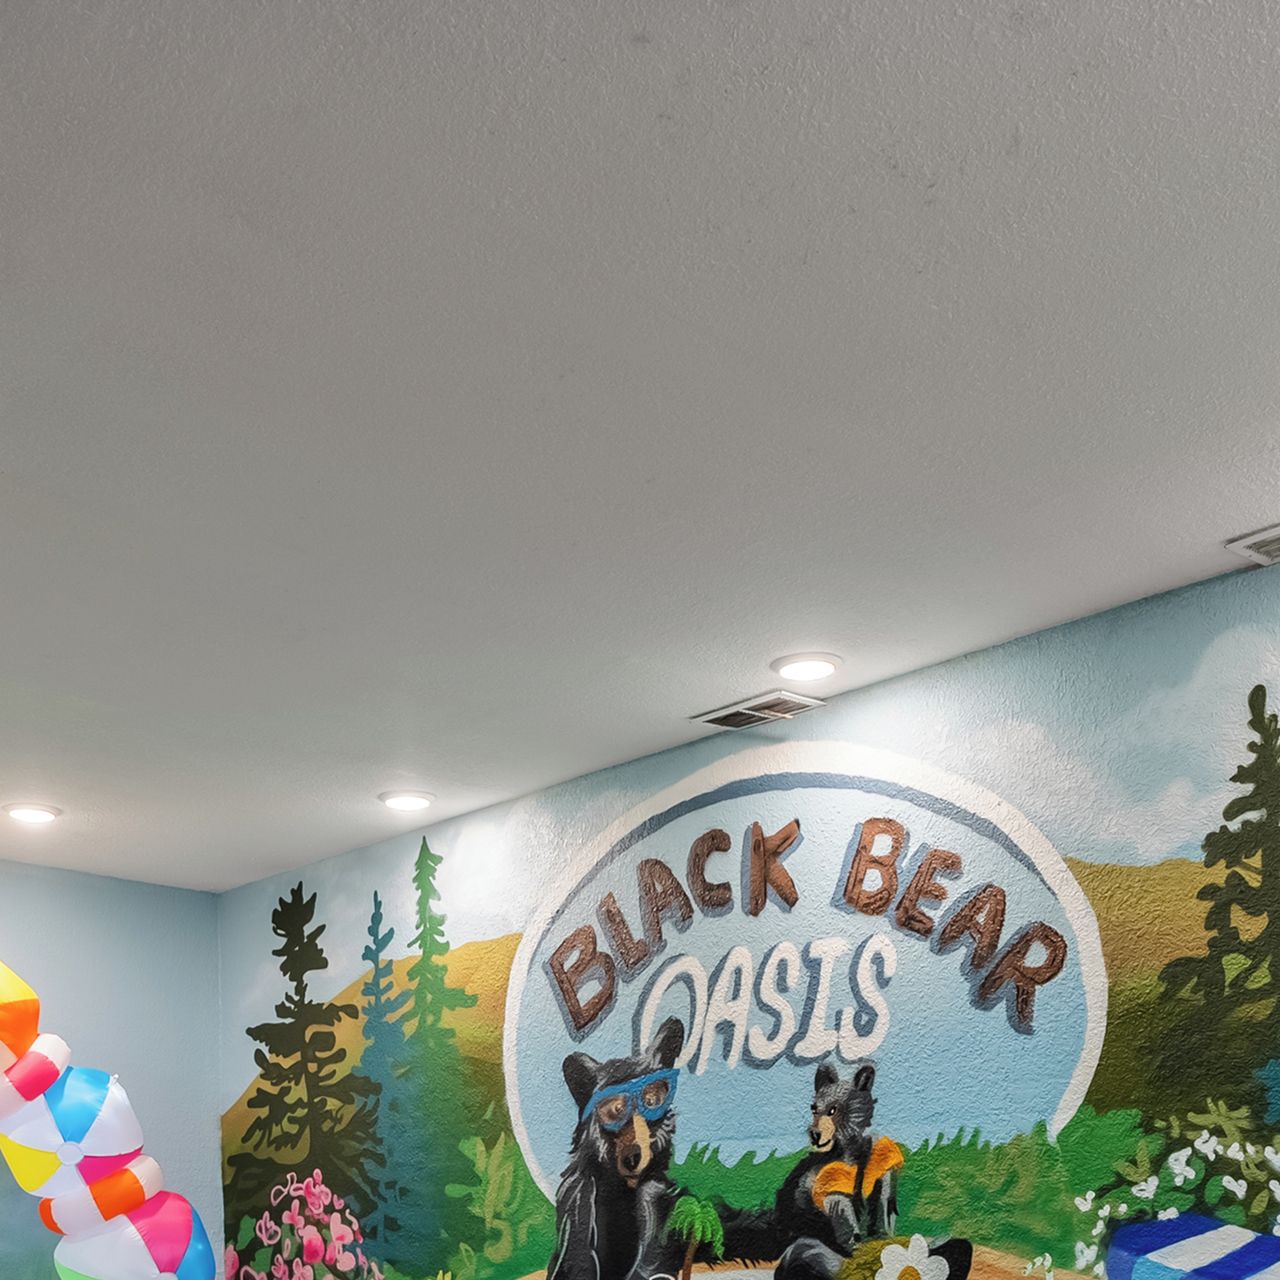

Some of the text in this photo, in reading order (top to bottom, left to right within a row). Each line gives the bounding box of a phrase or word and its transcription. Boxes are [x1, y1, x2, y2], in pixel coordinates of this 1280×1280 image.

[549, 816, 1069, 1036] BLACK BEAR
[636, 932, 898, 1076] OASIS
